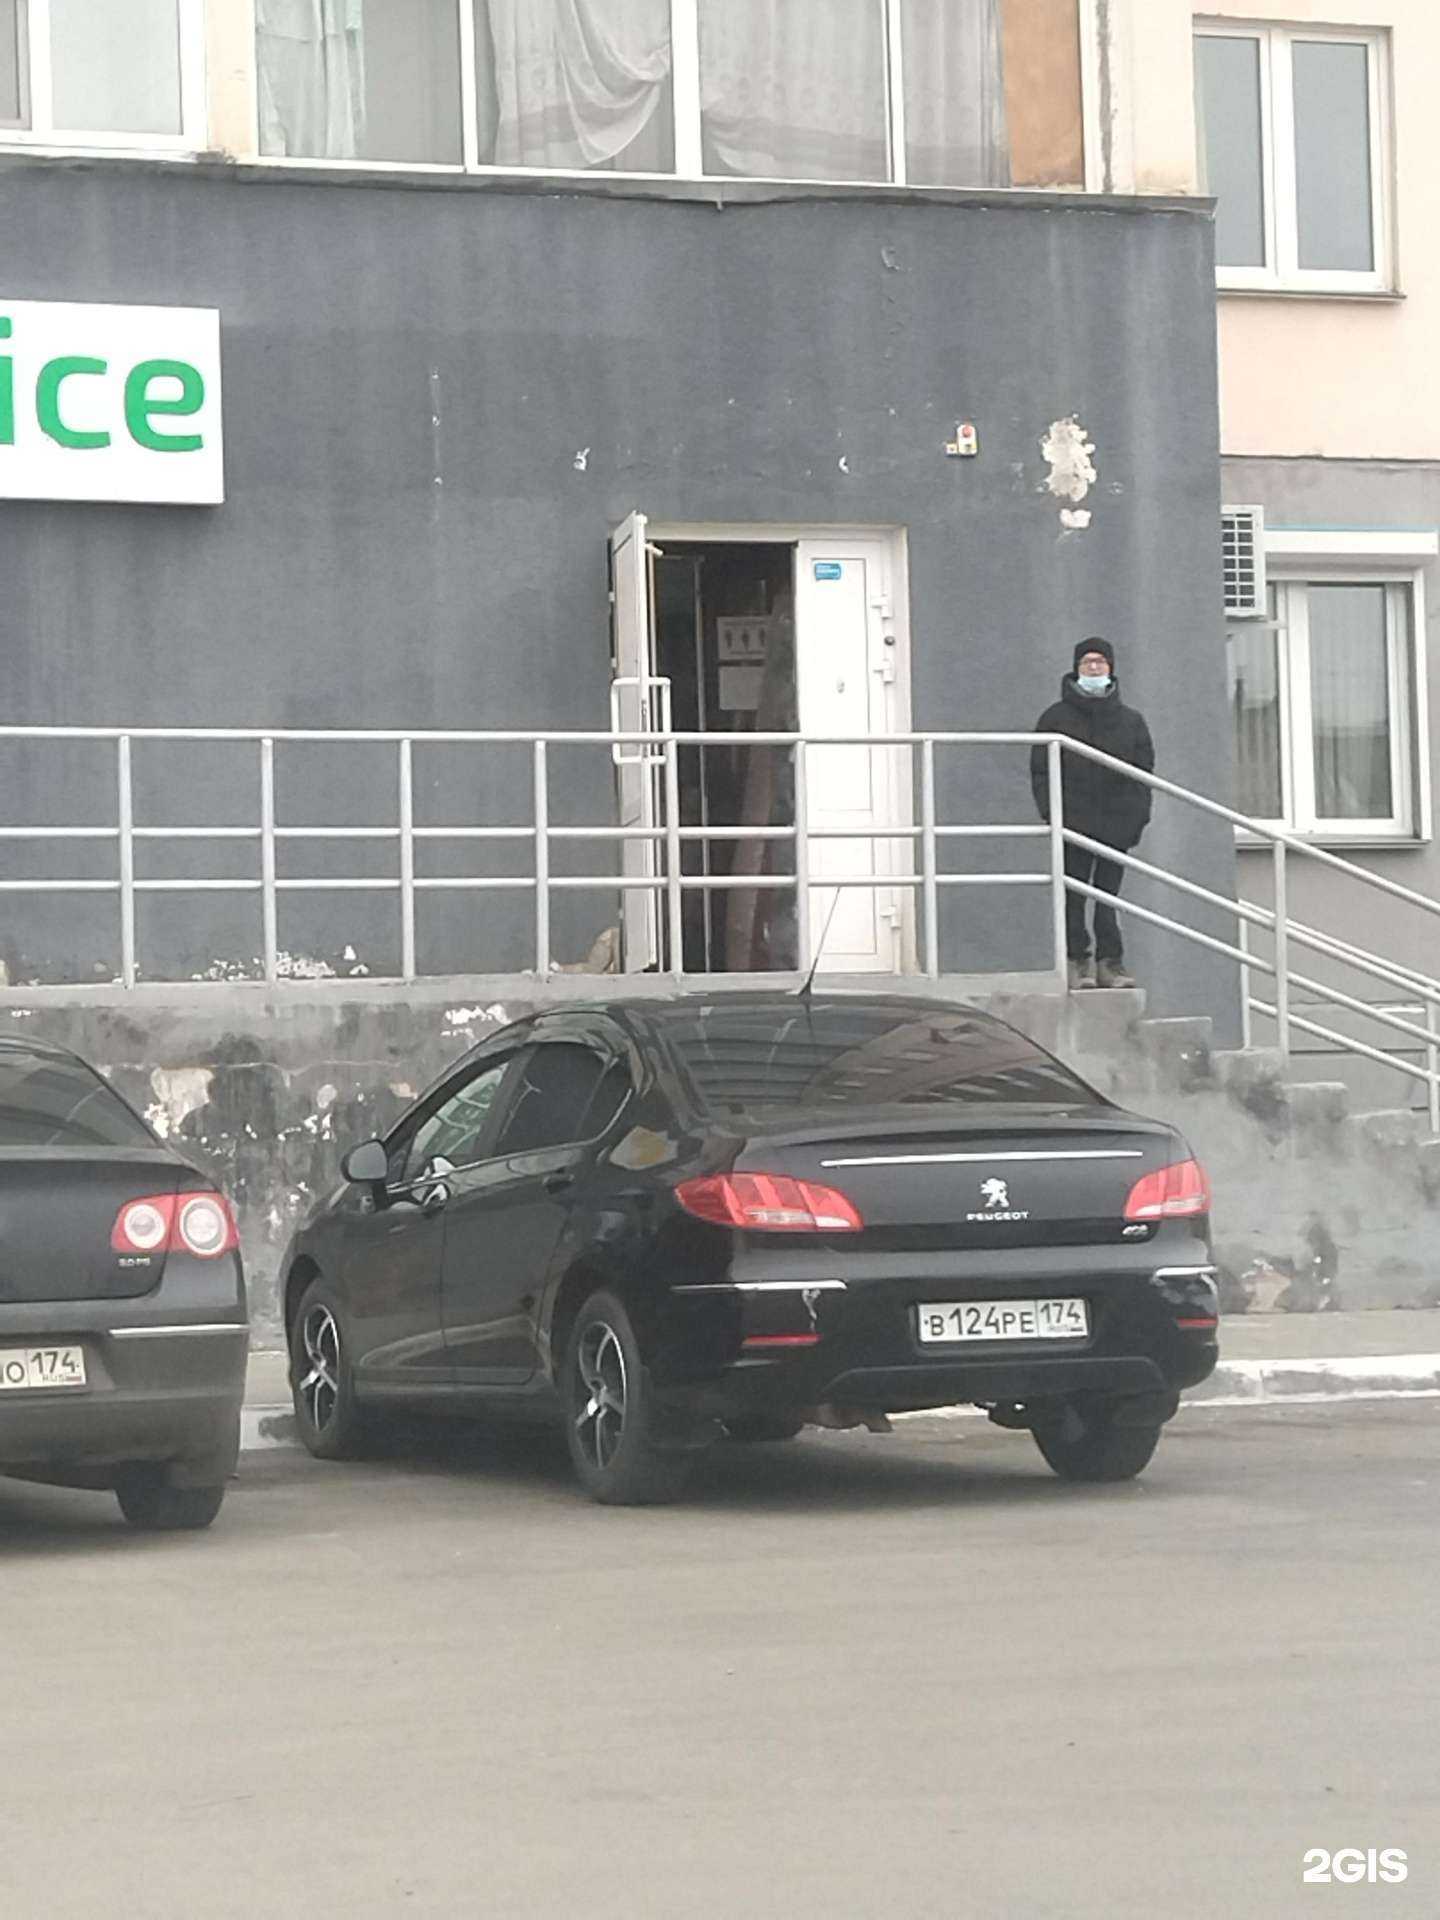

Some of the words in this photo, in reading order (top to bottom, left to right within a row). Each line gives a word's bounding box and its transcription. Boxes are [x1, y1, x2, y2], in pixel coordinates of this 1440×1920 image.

[0, 316, 205, 453] ice
[966, 1211, 1029, 1221] PEUGEOT
[1040, 1302, 1081, 1324] 174
[0, 1361, 25, 1384] О
[31, 1351, 75, 1373] 174
